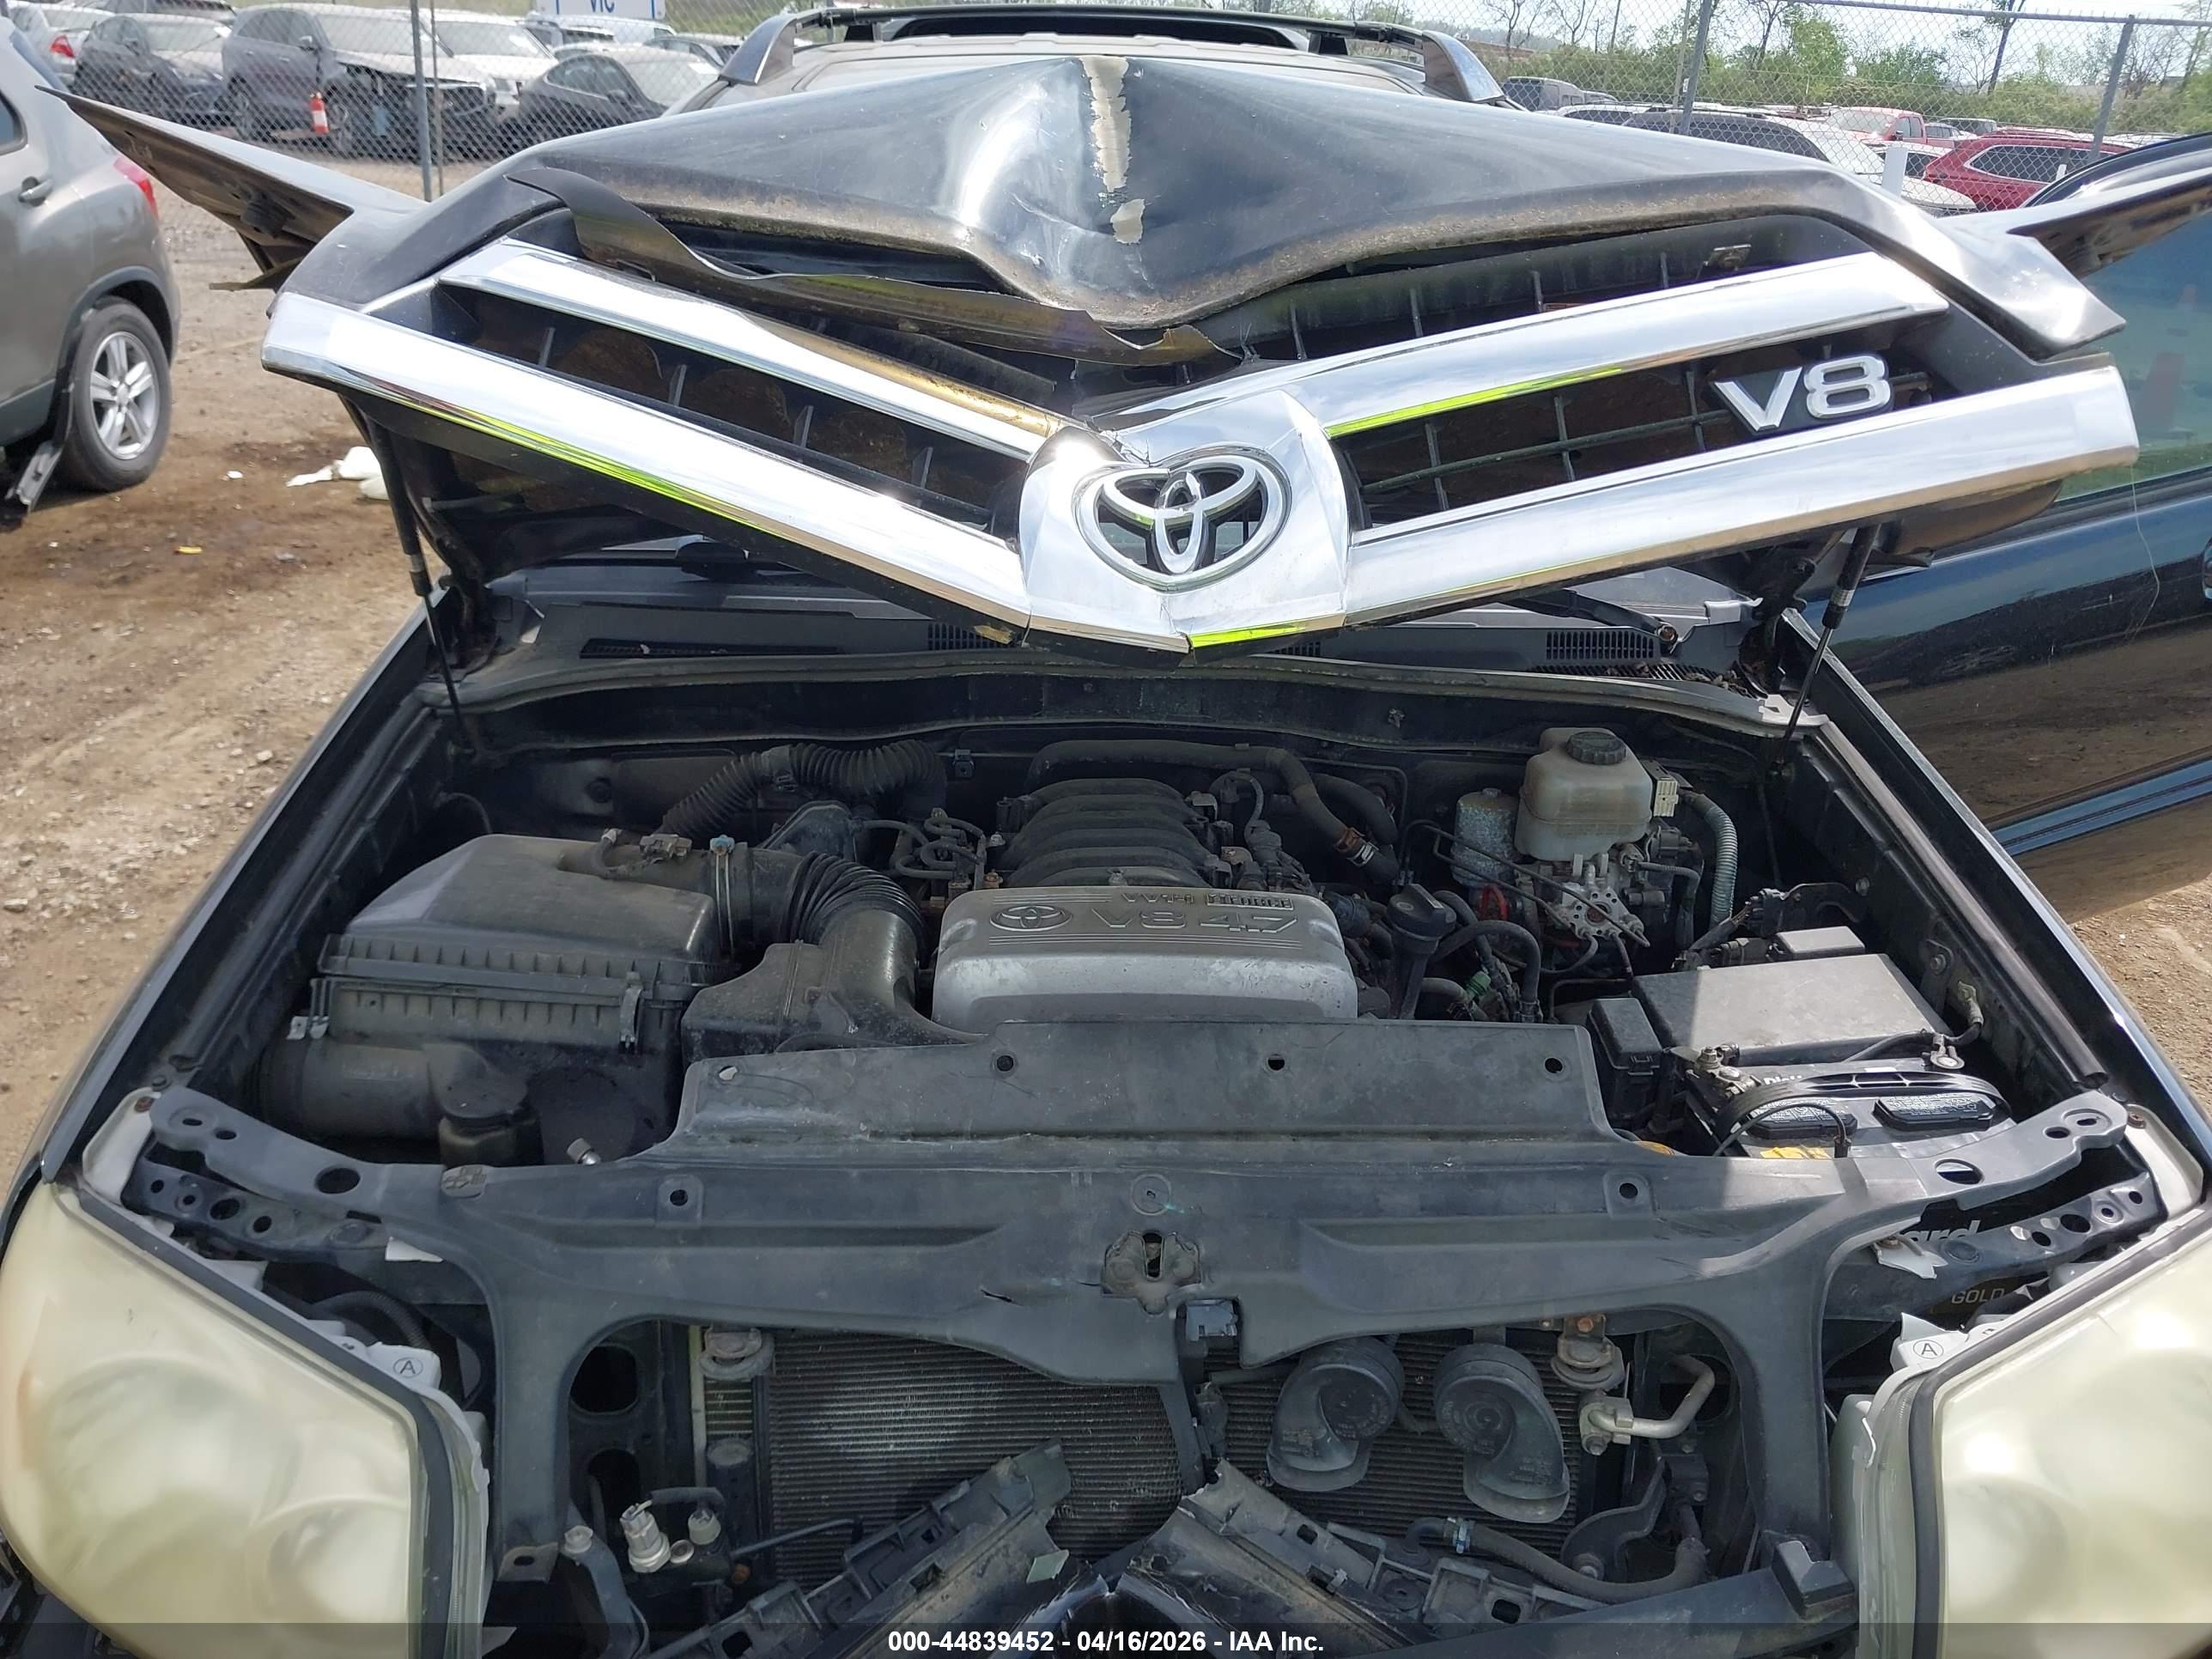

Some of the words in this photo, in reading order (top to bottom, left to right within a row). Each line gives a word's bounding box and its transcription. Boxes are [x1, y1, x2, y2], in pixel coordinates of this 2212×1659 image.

[1715, 356, 1891, 431] V8
[1091, 908, 1186, 929] V8
[1951, 1288, 2005, 1304] GOLD
